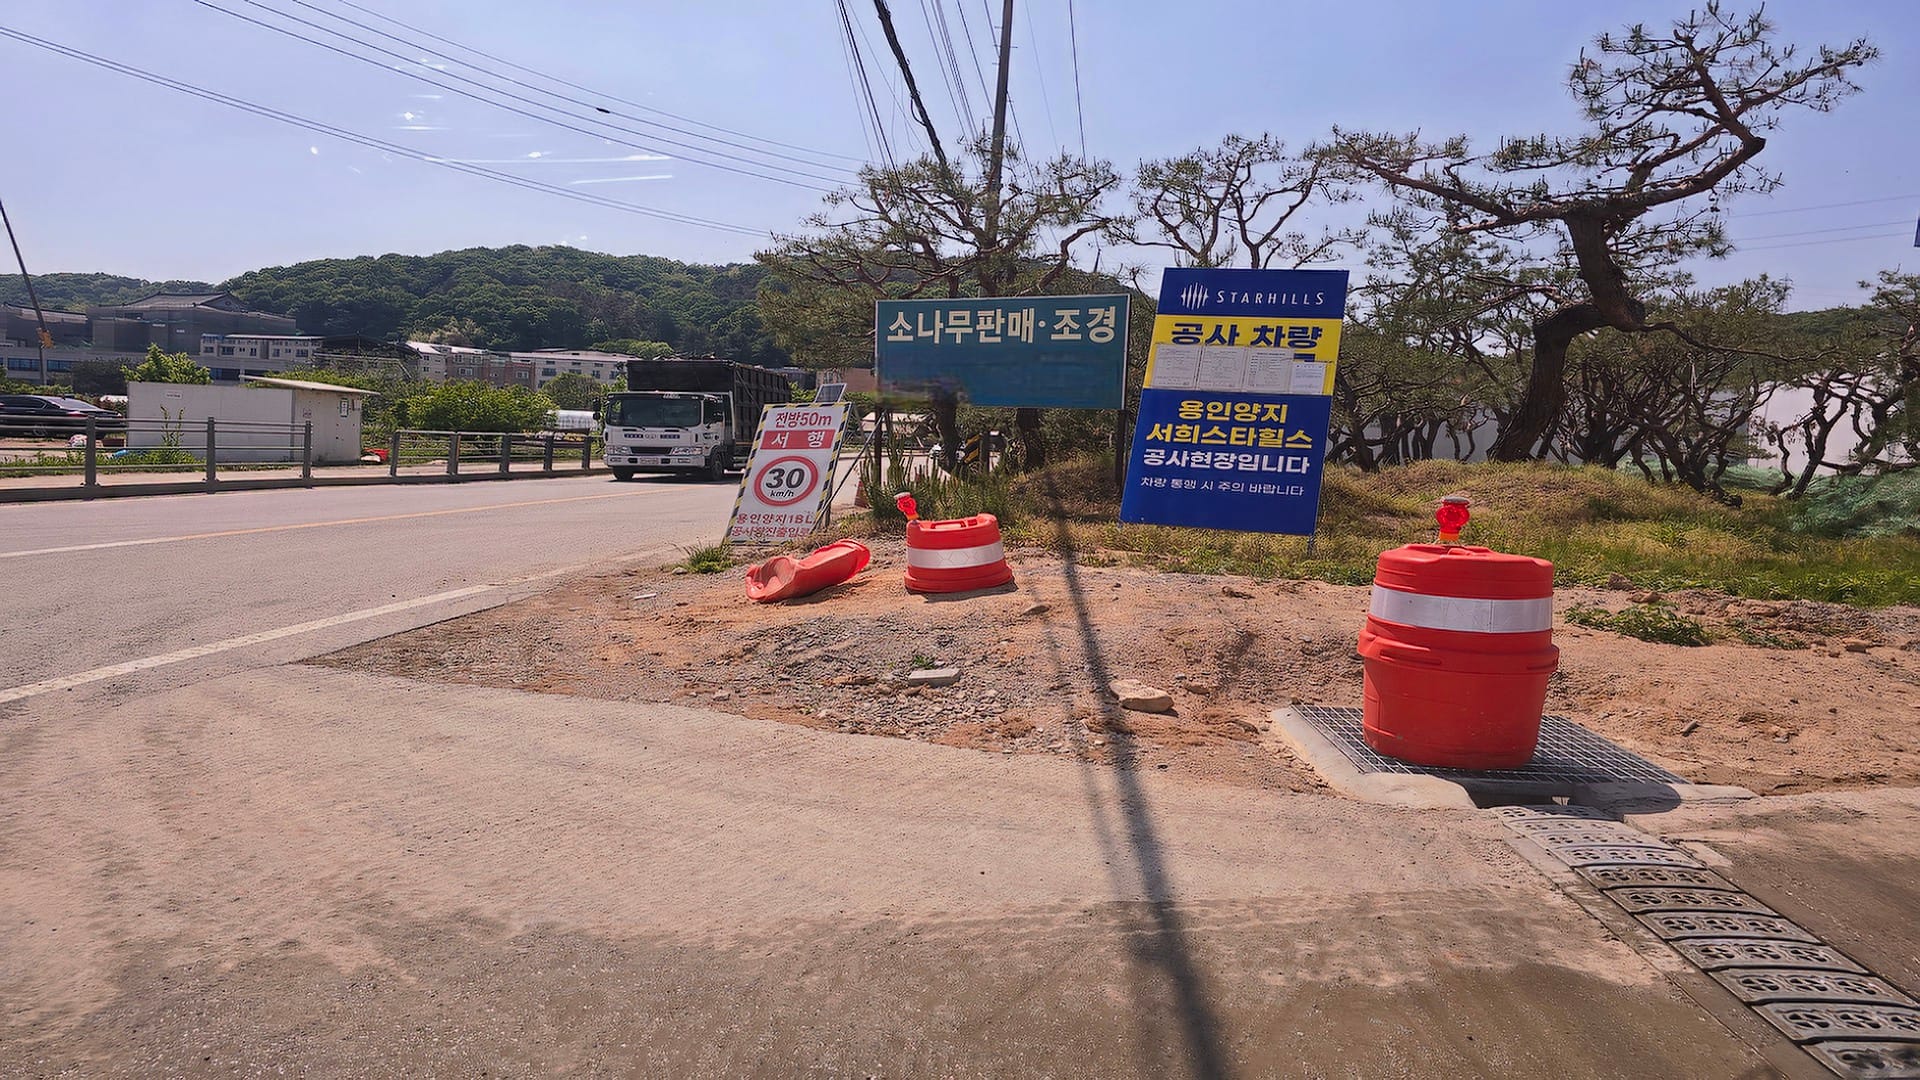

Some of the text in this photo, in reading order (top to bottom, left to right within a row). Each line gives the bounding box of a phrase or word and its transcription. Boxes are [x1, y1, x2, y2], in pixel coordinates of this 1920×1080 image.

[1216, 290, 1325, 306] STARHILLS
[887, 306, 1116, 344] 소나무판매·조경
[1171, 322, 1323, 349] 공사 차량
[775, 411, 832, 429] 전방50m
[1178, 400, 1288, 424] 용인양지
[1146, 423, 1313, 449] 서희스타힐스
[1143, 448, 1310, 474] 공사현장입니다
[765, 467, 805, 489] 30
[1140, 477, 1304, 496] 차량 통행 시 주의 바랍니다
[769, 490, 795, 498] km/h
